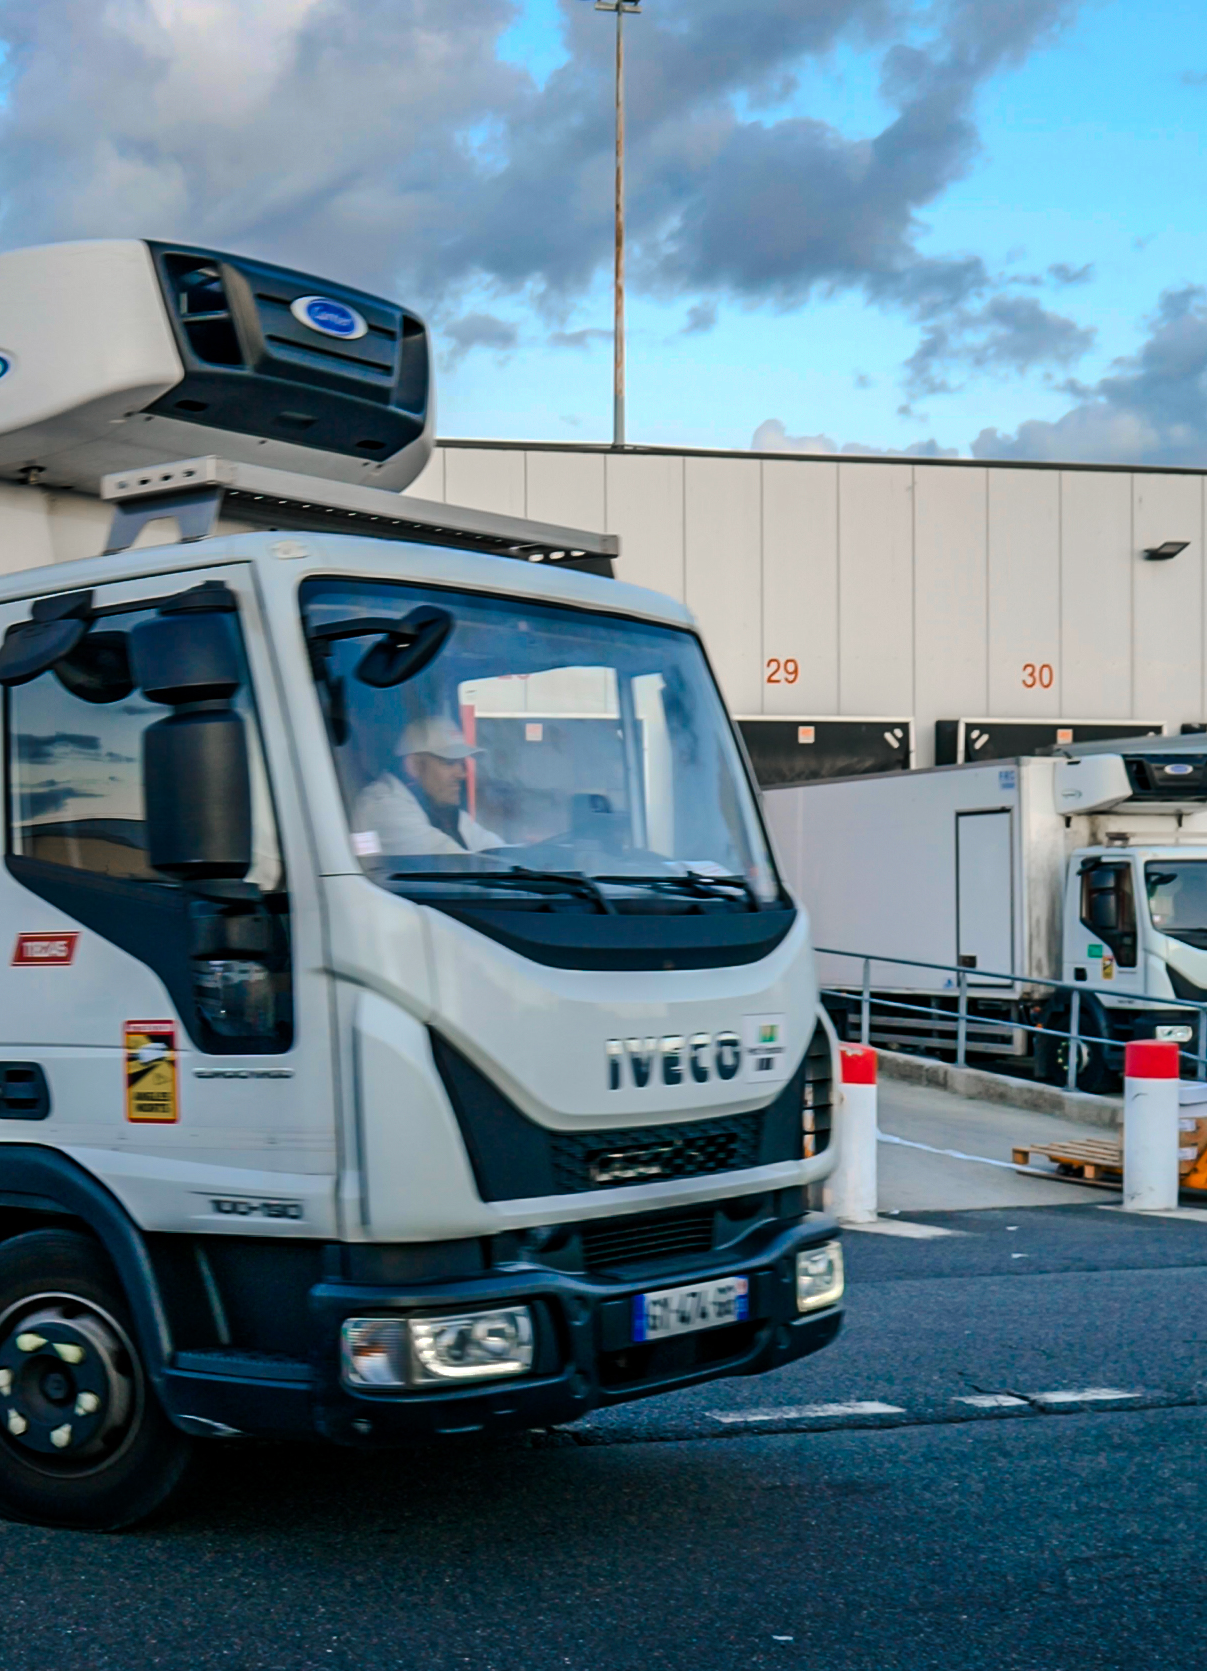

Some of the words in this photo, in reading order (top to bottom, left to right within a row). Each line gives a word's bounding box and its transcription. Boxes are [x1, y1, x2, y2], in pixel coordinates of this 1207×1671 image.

[766, 658, 799, 684] 29
[1021, 663, 1054, 688] 30
[606, 1031, 741, 1091] IVECO
